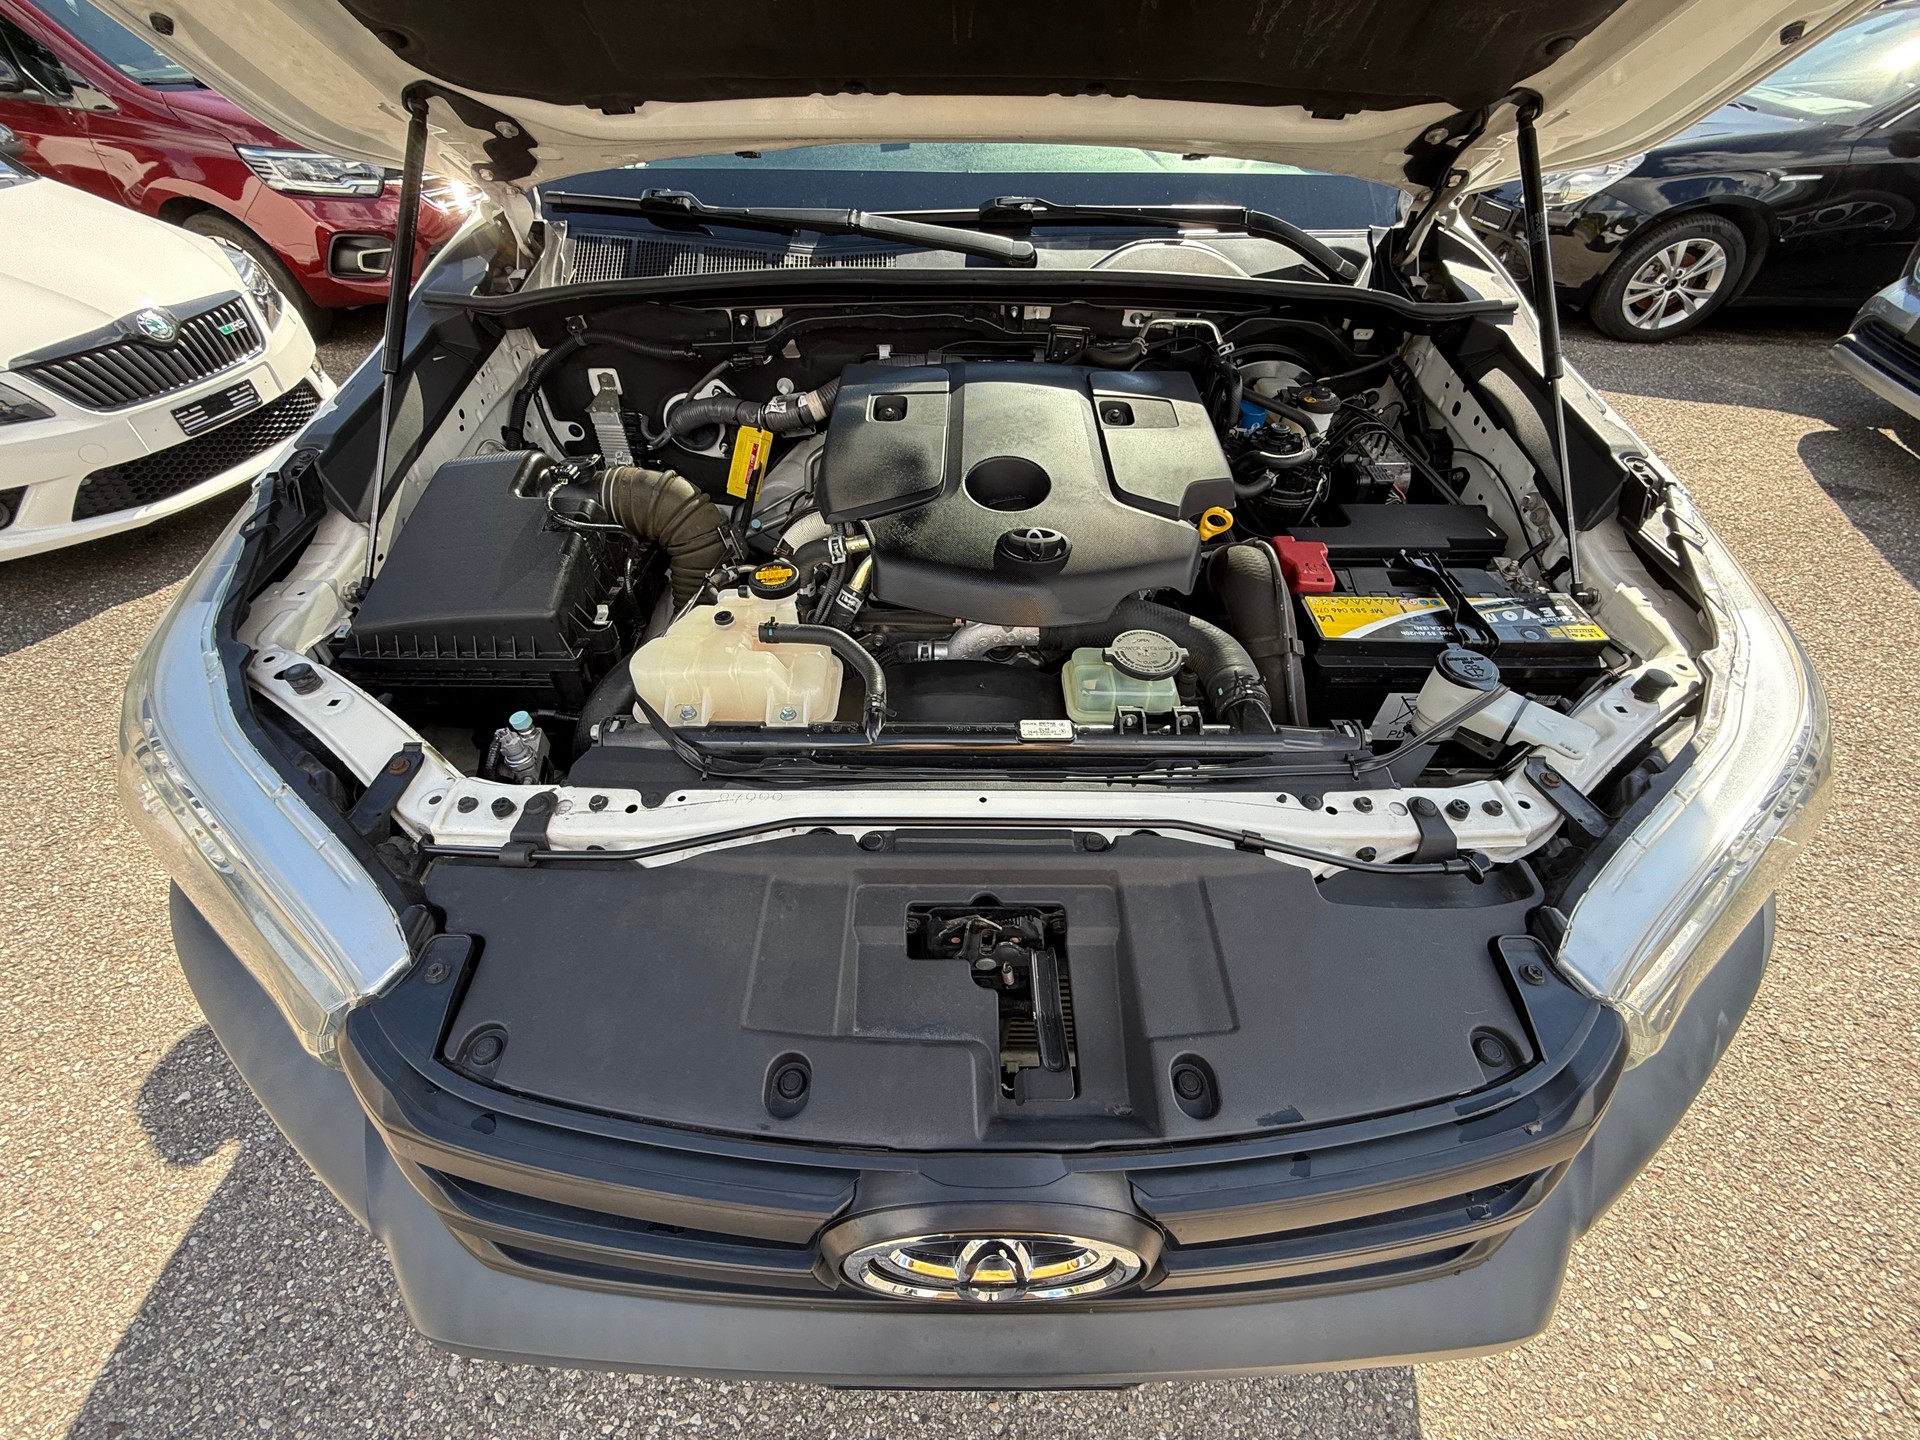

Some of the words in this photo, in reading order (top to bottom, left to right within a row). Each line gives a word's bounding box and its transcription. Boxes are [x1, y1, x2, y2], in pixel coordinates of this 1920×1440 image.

[1317, 614, 1335, 623] L4
[1537, 615, 1577, 623] Calcium
[1387, 730, 1405, 739] Pb
